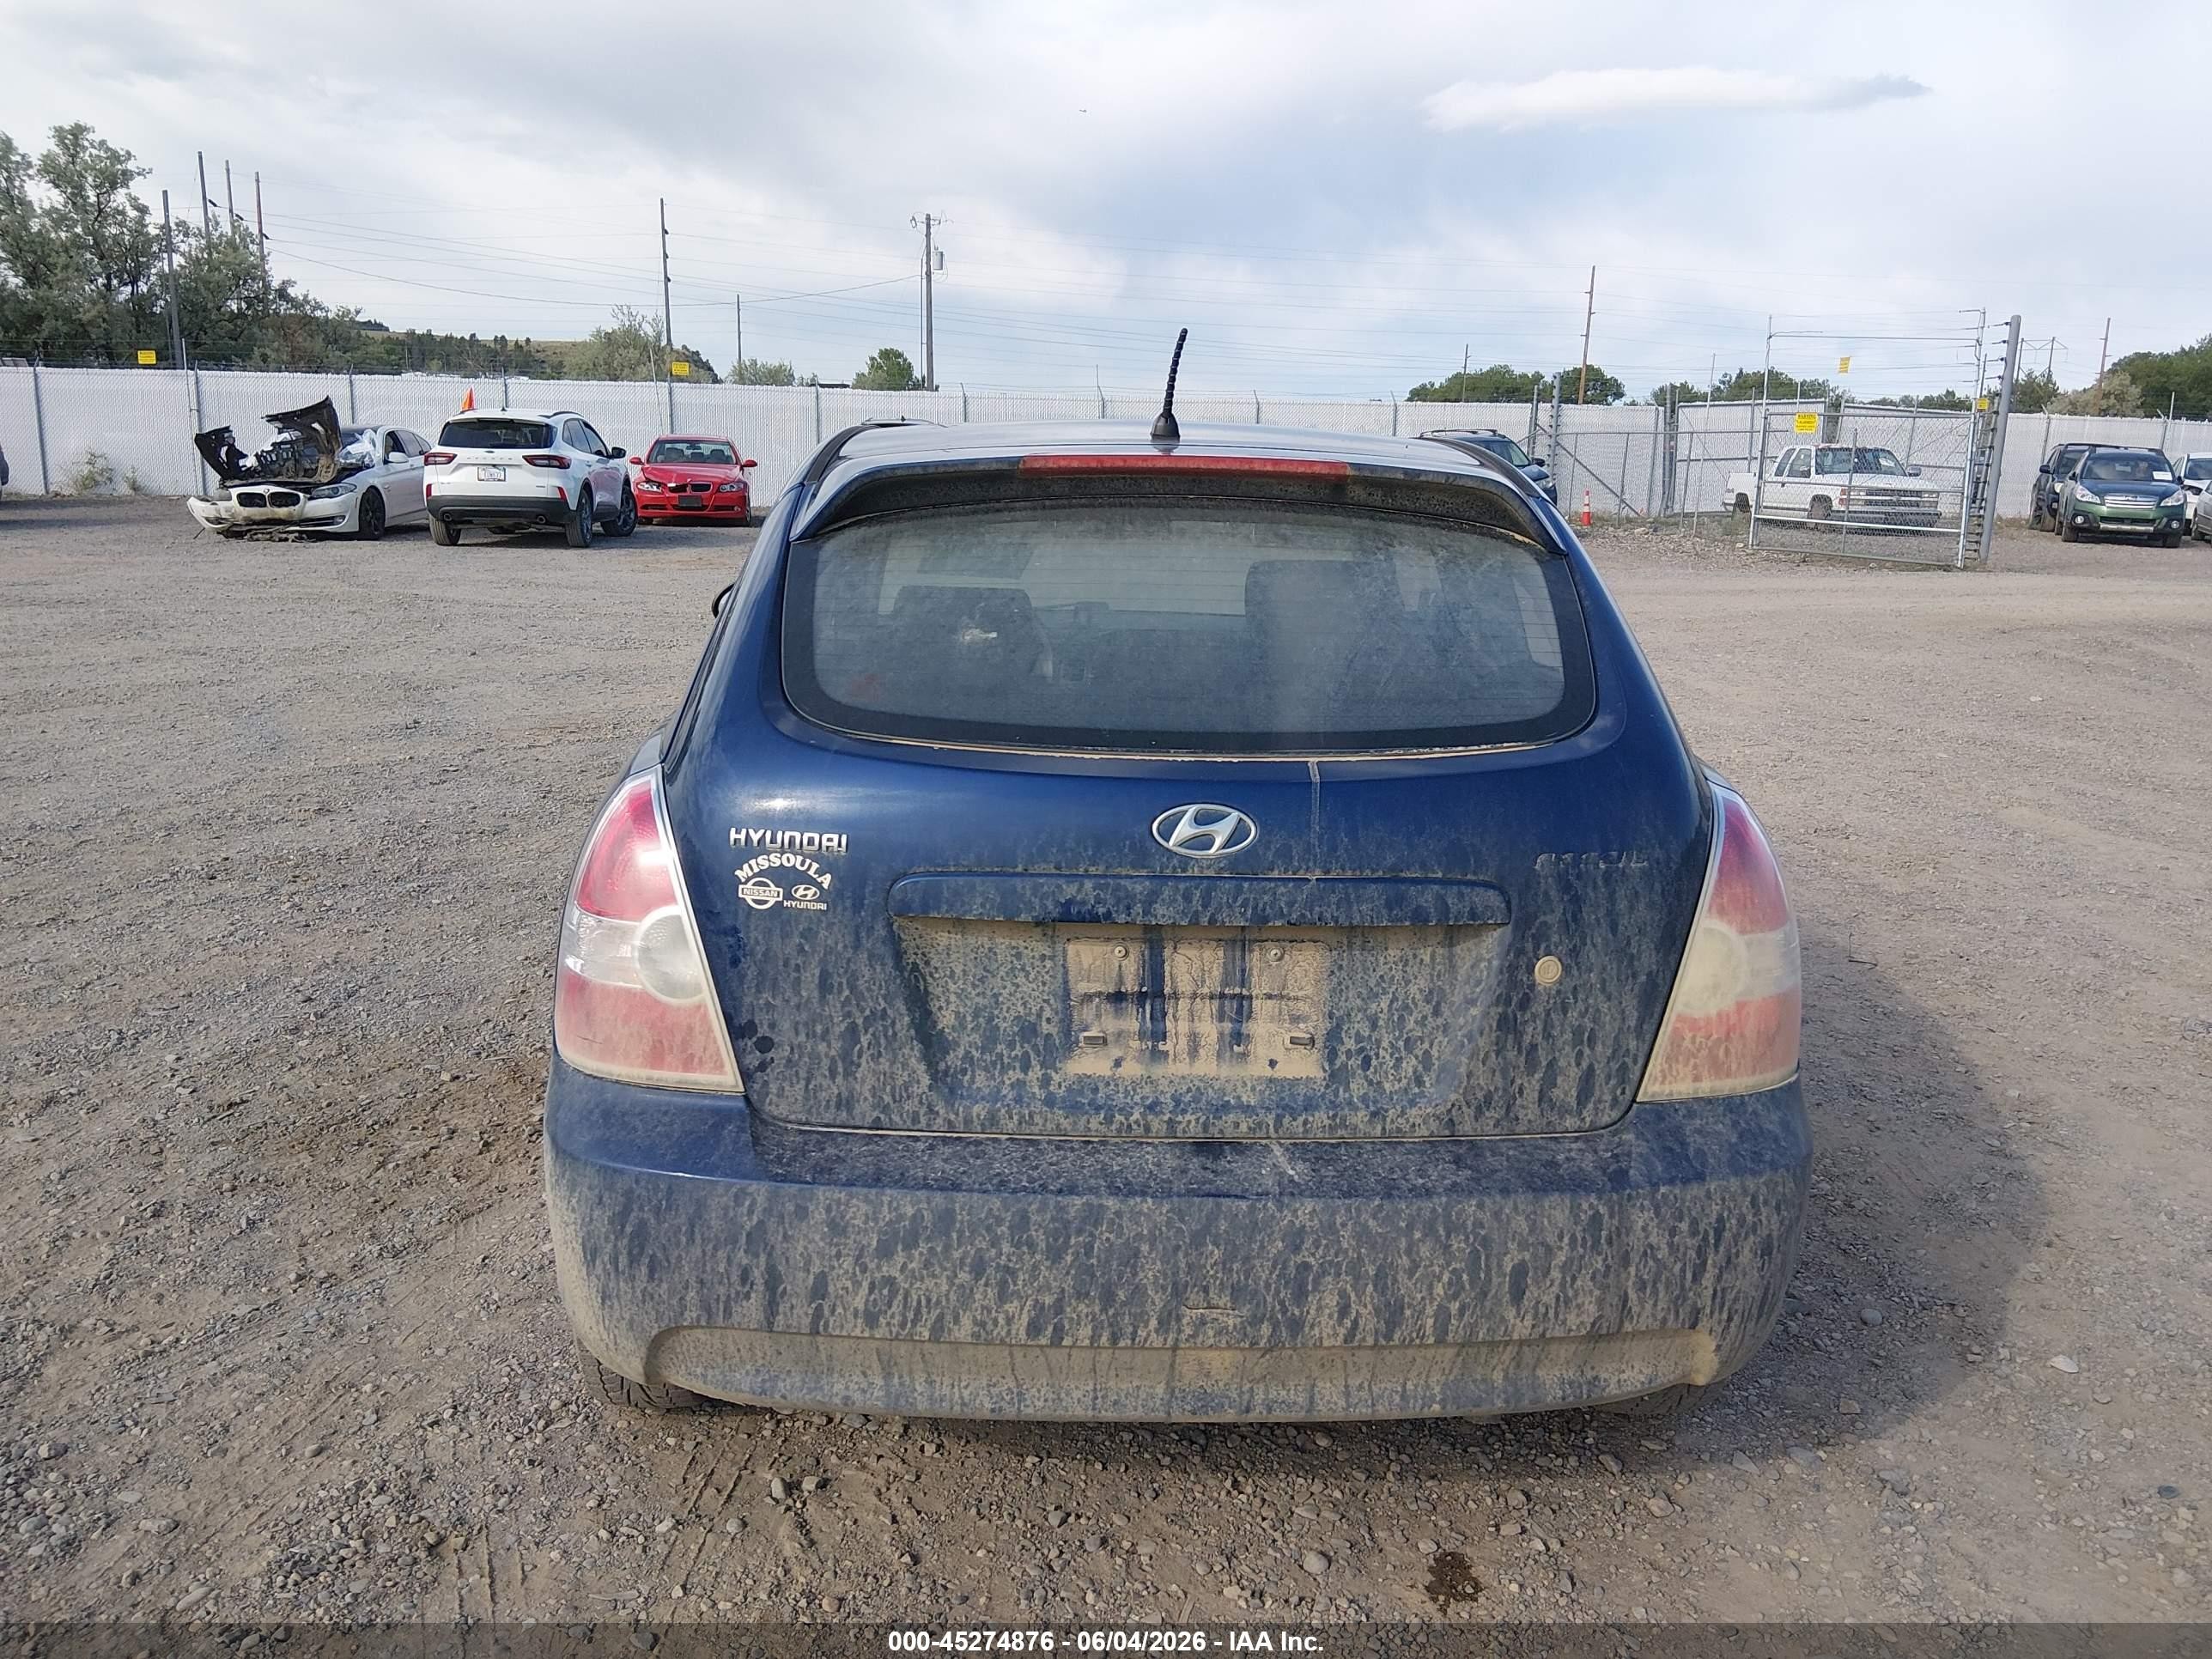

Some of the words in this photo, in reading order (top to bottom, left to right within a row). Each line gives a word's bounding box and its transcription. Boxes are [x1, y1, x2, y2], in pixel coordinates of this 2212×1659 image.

[729, 827, 848, 854] HYUNDAI
[734, 853, 832, 890] MISSOULA
[743, 888, 778, 897] NISSAN
[783, 900, 827, 910] HYUNDAI
